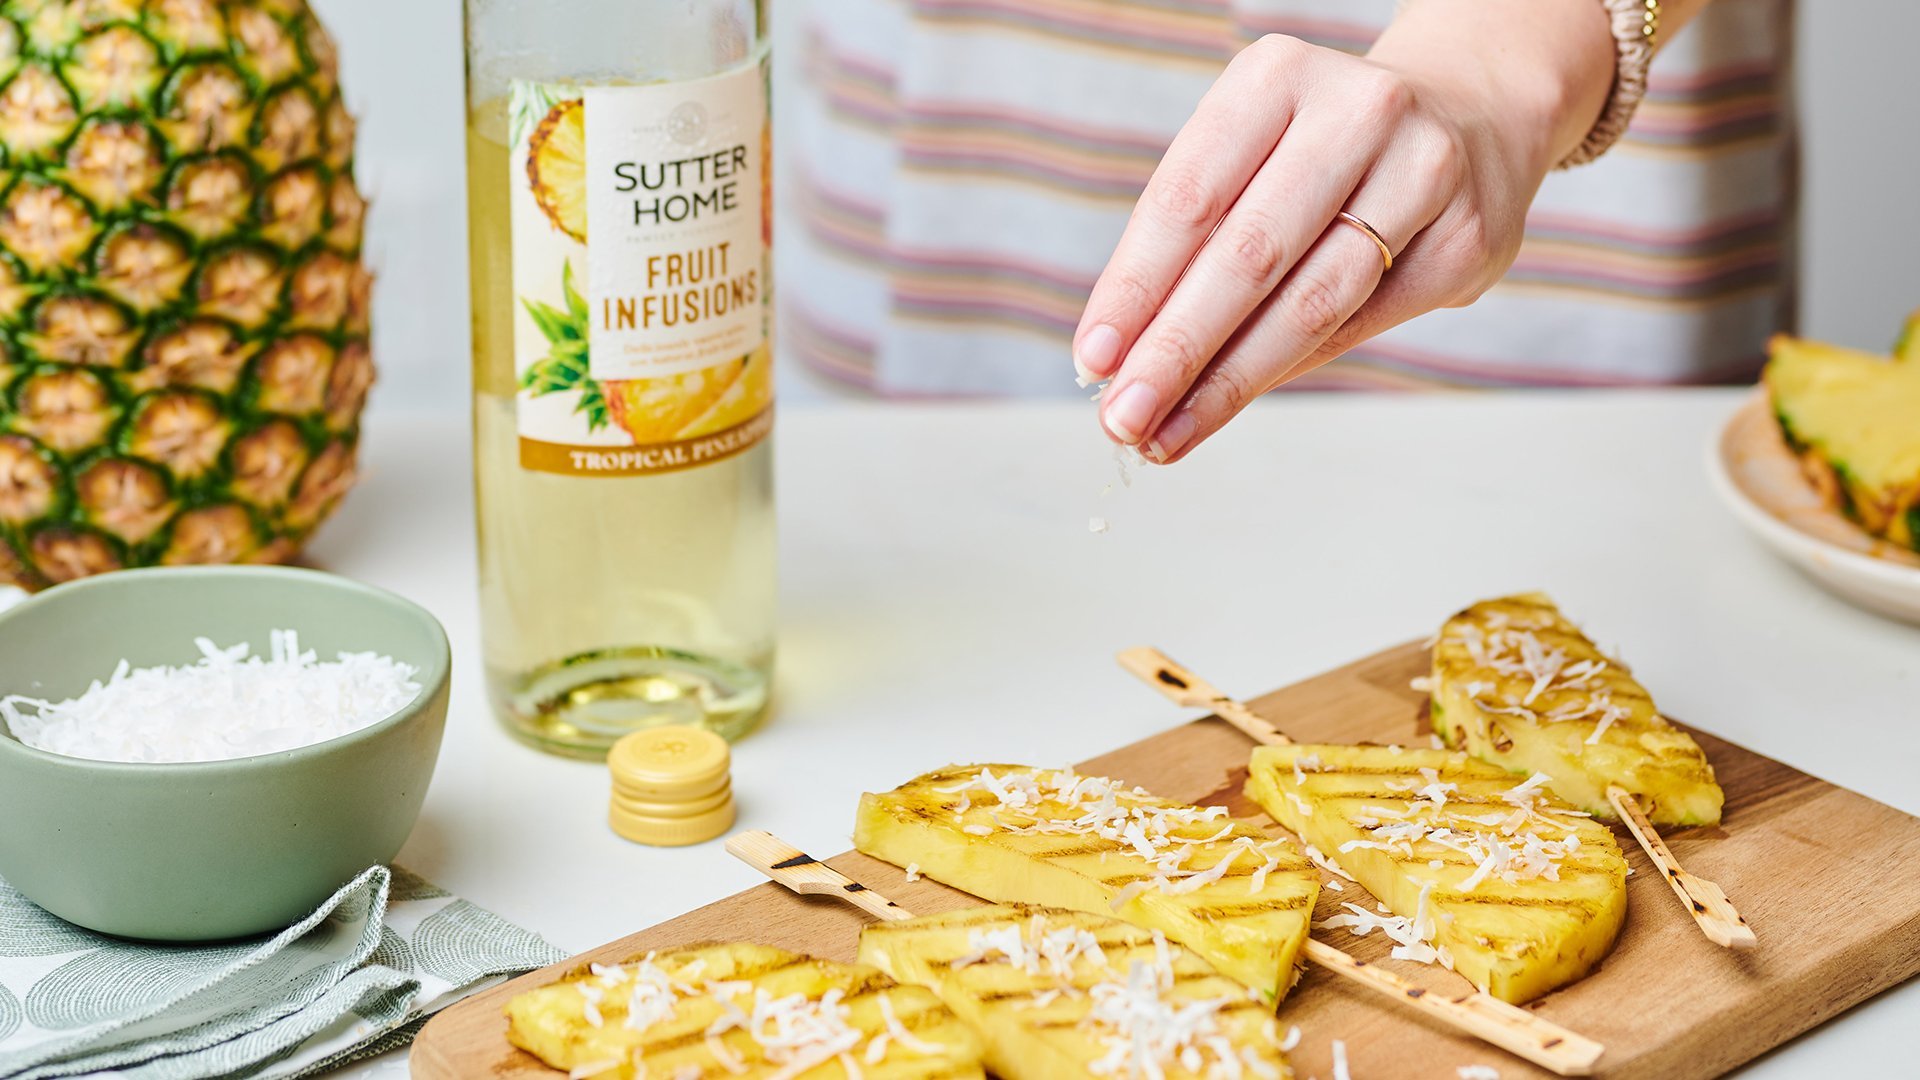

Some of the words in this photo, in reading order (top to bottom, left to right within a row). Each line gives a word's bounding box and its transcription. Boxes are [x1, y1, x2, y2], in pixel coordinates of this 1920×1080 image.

[614, 144, 748, 192] SUTTER
[634, 181, 738, 226] HOME
[647, 242, 730, 289] FRUIT
[603, 269, 757, 331] INFUSIONS
[569, 446, 688, 470] TROPICAL
